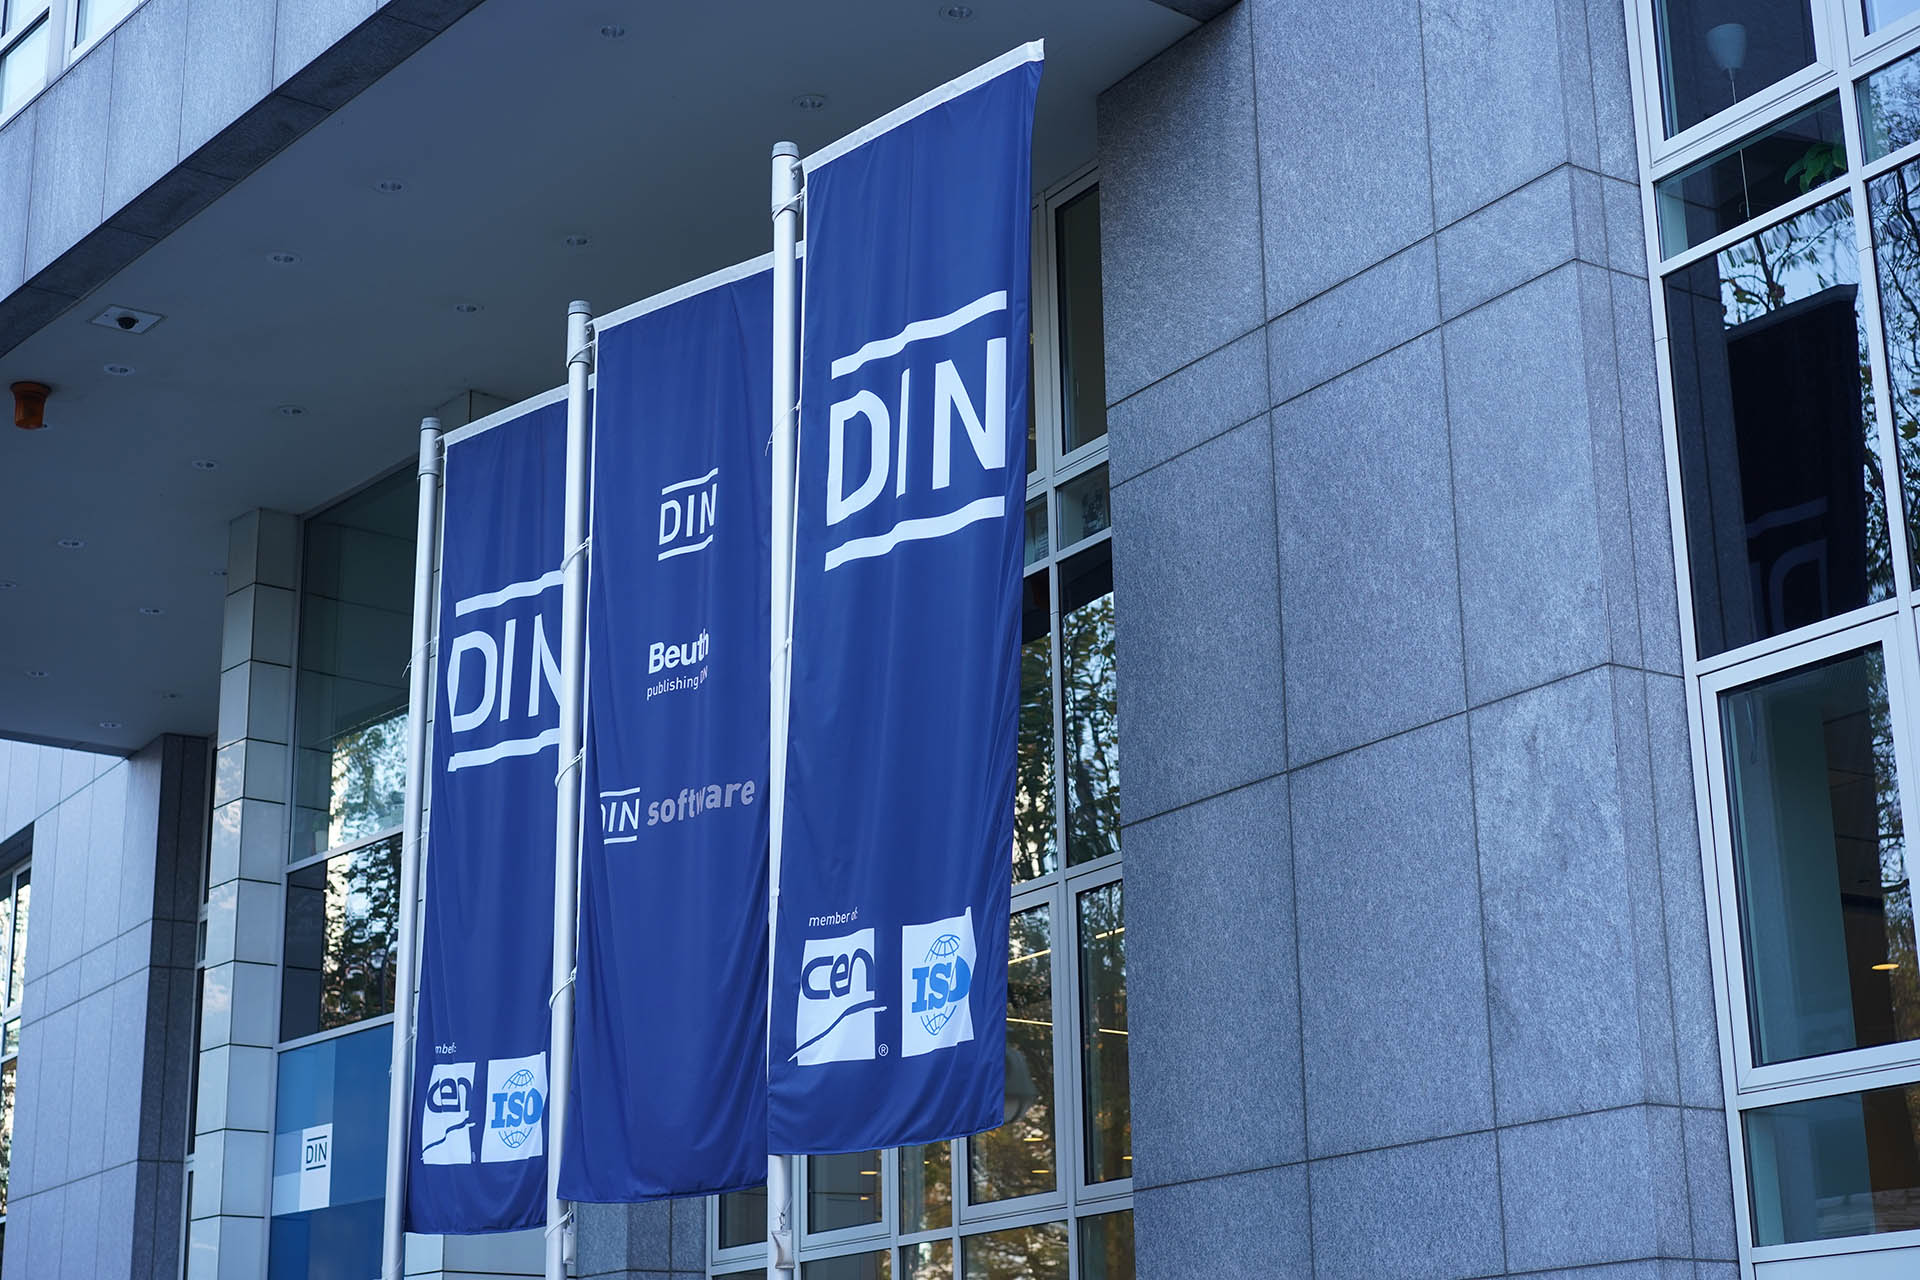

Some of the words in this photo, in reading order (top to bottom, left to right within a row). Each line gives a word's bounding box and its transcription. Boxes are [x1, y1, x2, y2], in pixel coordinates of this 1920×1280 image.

[826, 337, 1007, 526] DIN
[658, 482, 717, 546] DIN
[646, 676, 699, 701] publishing
[647, 780, 755, 826] software
[808, 911, 850, 927] member
[491, 1087, 543, 1129] ISO
[305, 1141, 328, 1164] DIN
